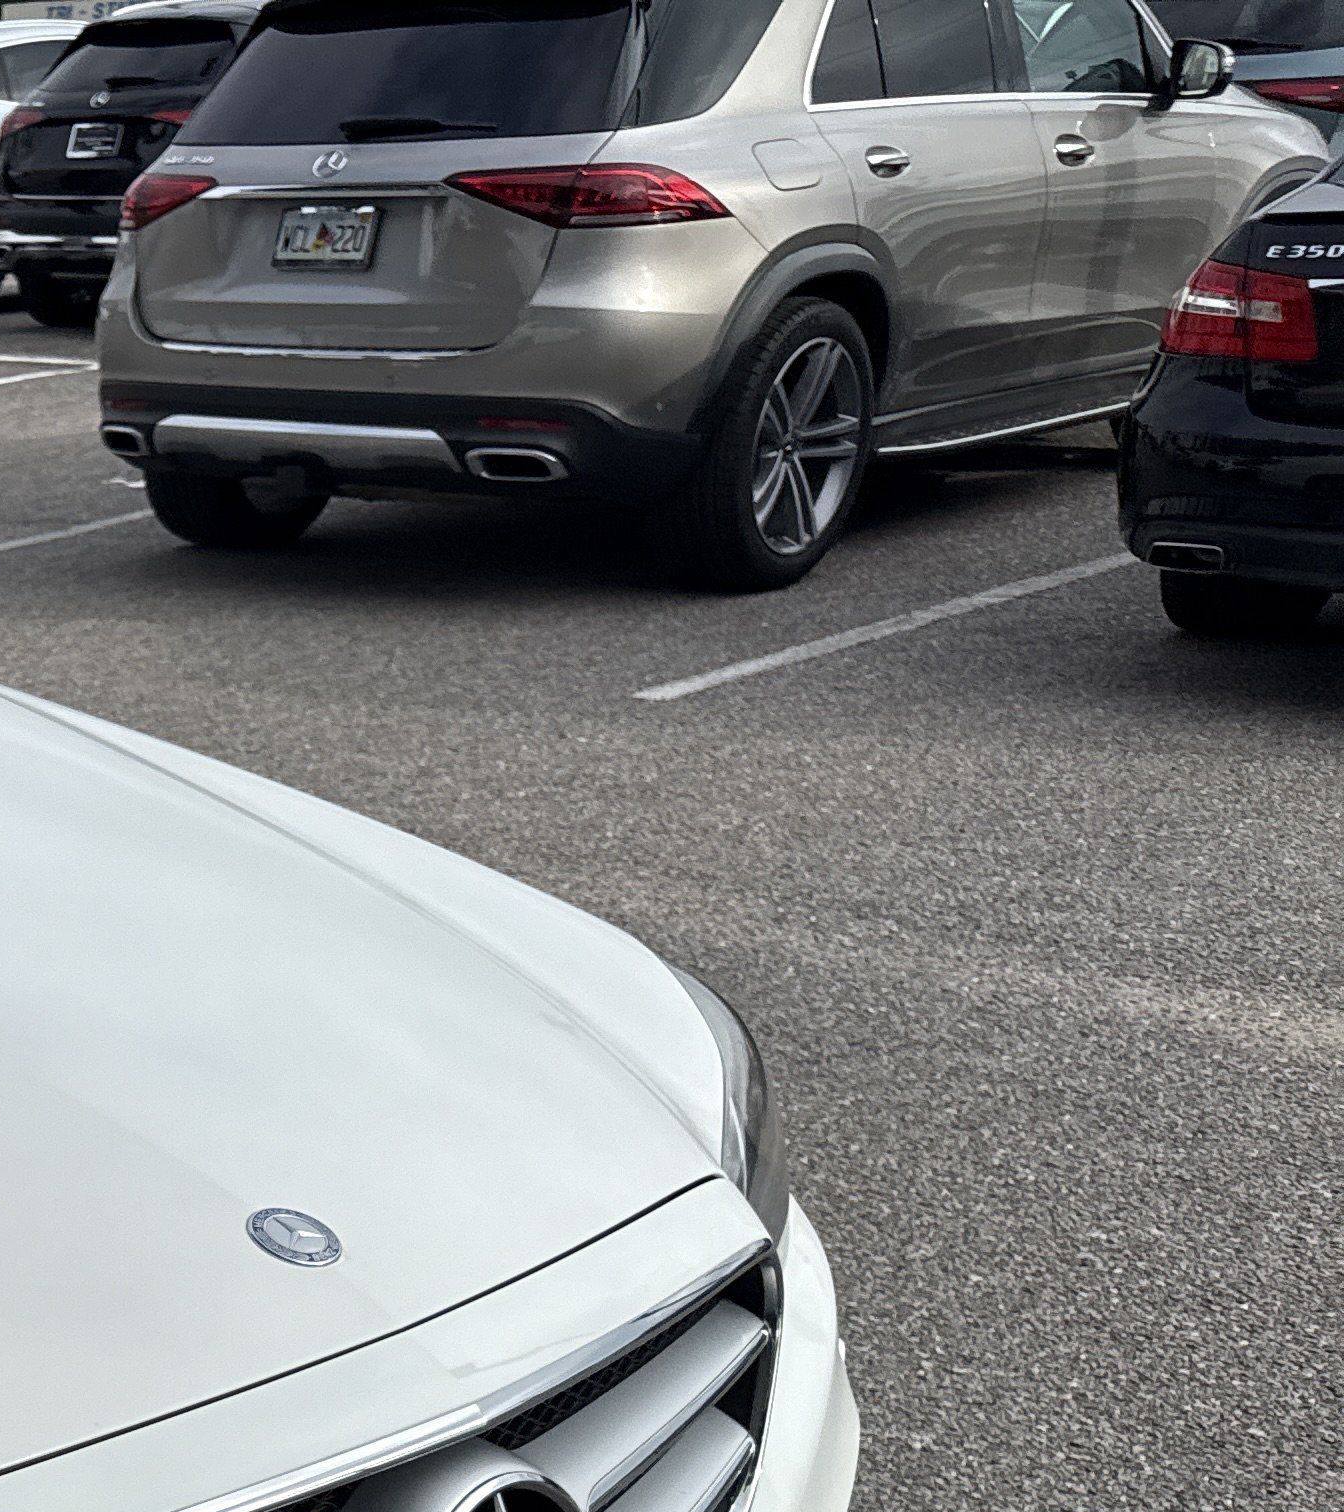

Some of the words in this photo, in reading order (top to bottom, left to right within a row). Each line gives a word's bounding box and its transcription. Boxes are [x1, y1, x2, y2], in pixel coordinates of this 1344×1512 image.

[332, 225, 367, 253] 220
[1265, 245, 1286, 259] E
[1286, 244, 1344, 259] 350
